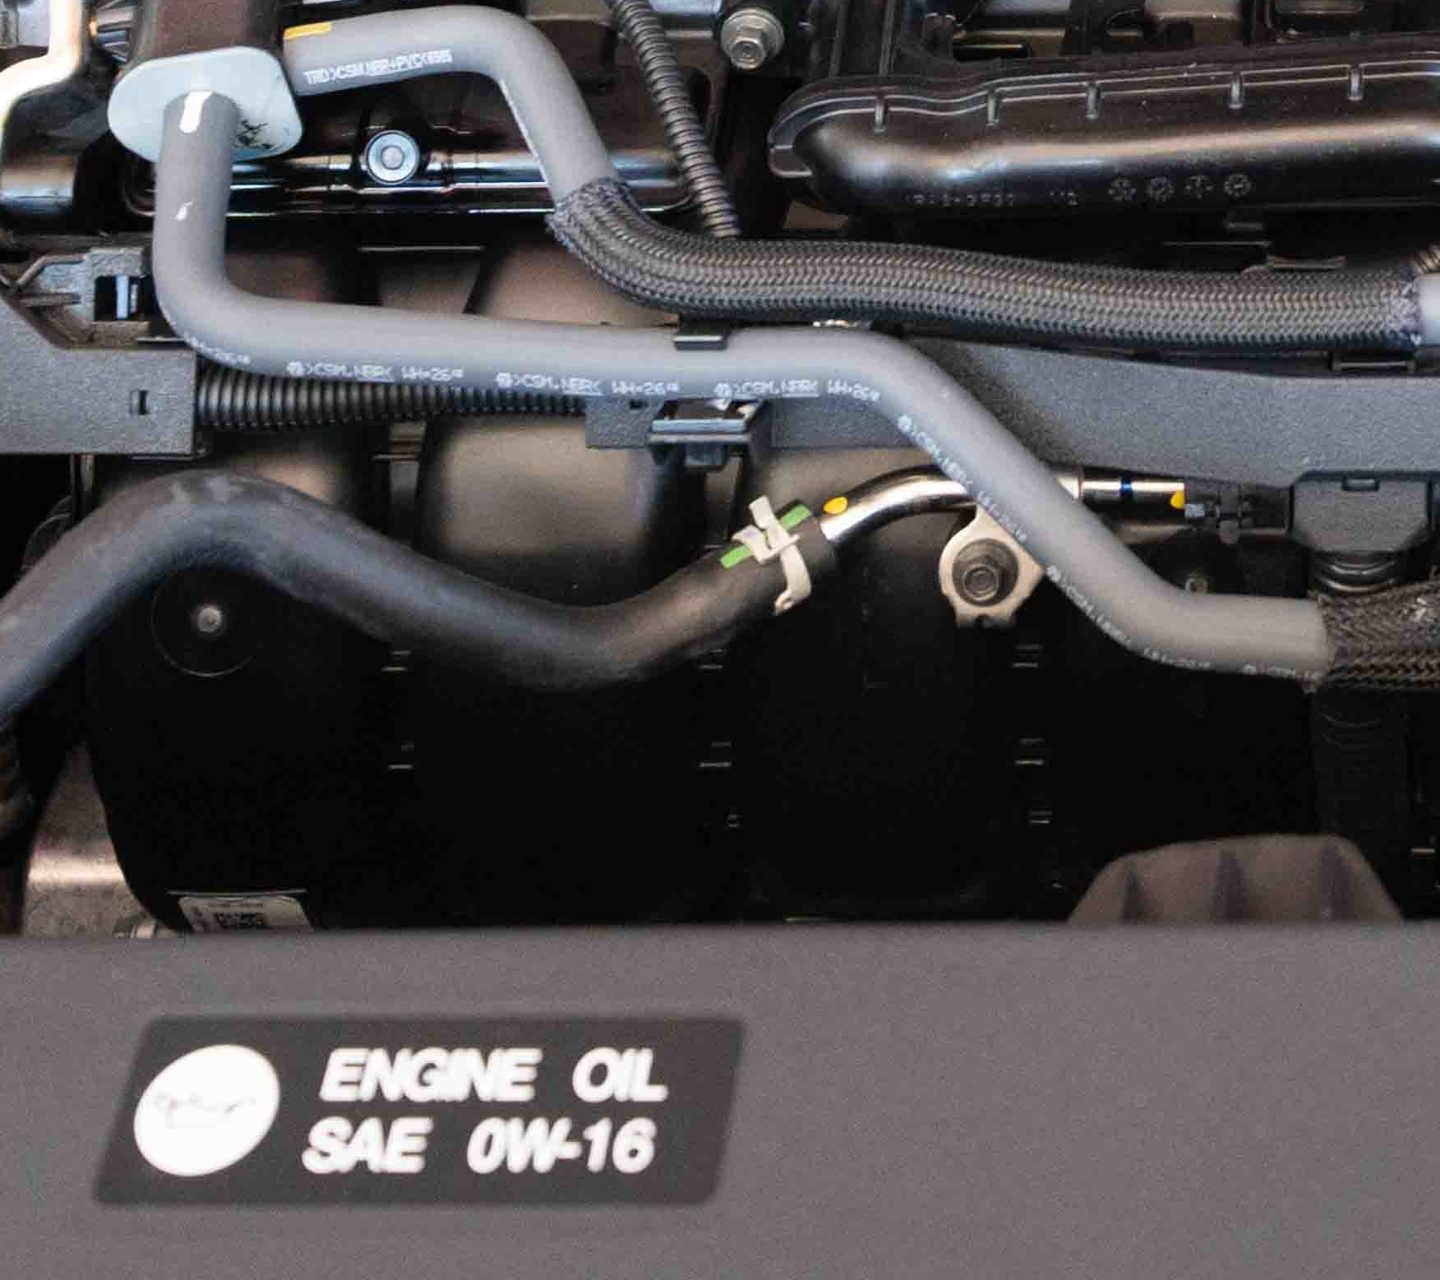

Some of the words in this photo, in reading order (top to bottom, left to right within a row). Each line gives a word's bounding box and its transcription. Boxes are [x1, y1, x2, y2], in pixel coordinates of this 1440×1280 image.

[318, 1047, 543, 1102] ENGINE
[570, 1047, 668, 1102] OIL
[301, 1117, 433, 1175] SAE
[465, 1117, 657, 1175] 0W-16
